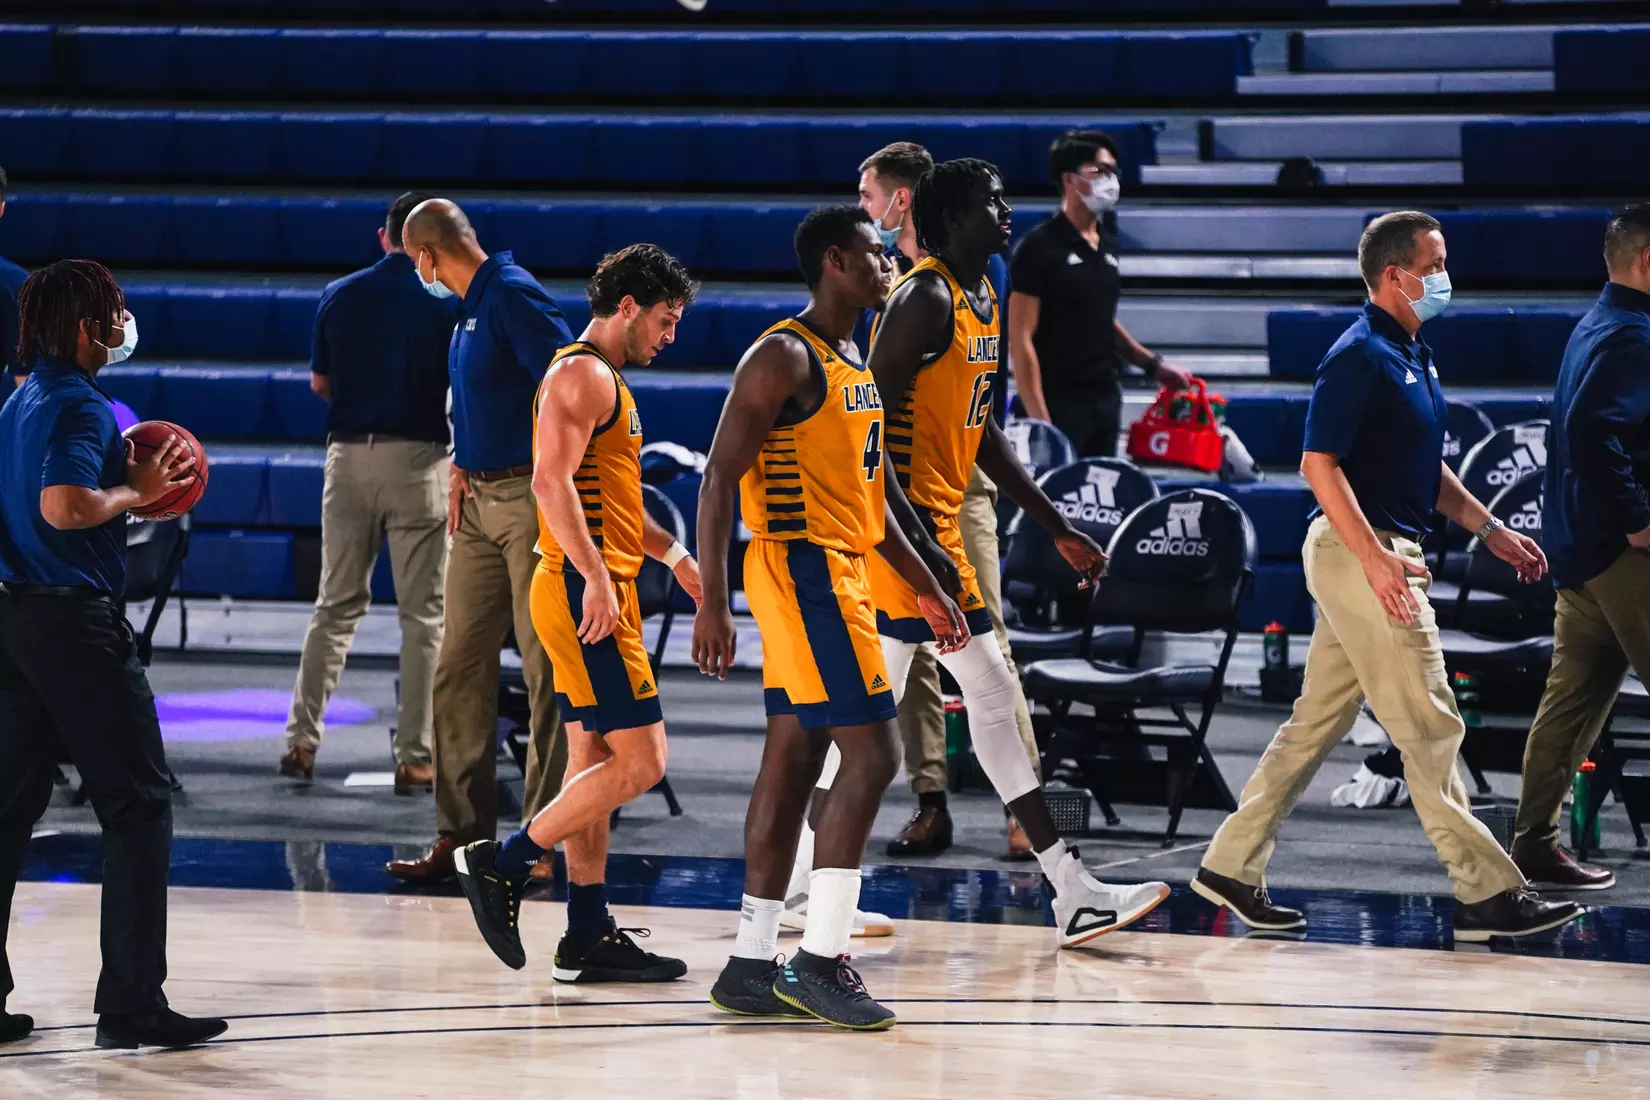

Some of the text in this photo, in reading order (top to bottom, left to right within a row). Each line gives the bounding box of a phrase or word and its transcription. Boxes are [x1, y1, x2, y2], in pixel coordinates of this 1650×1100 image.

[967, 335, 1000, 363] LANCE
[841, 382, 884, 412] LANCE
[965, 370, 997, 428] 12
[862, 419, 882, 482] 4
[1149, 431, 1170, 456] G
[1136, 537, 1209, 556] adidas
